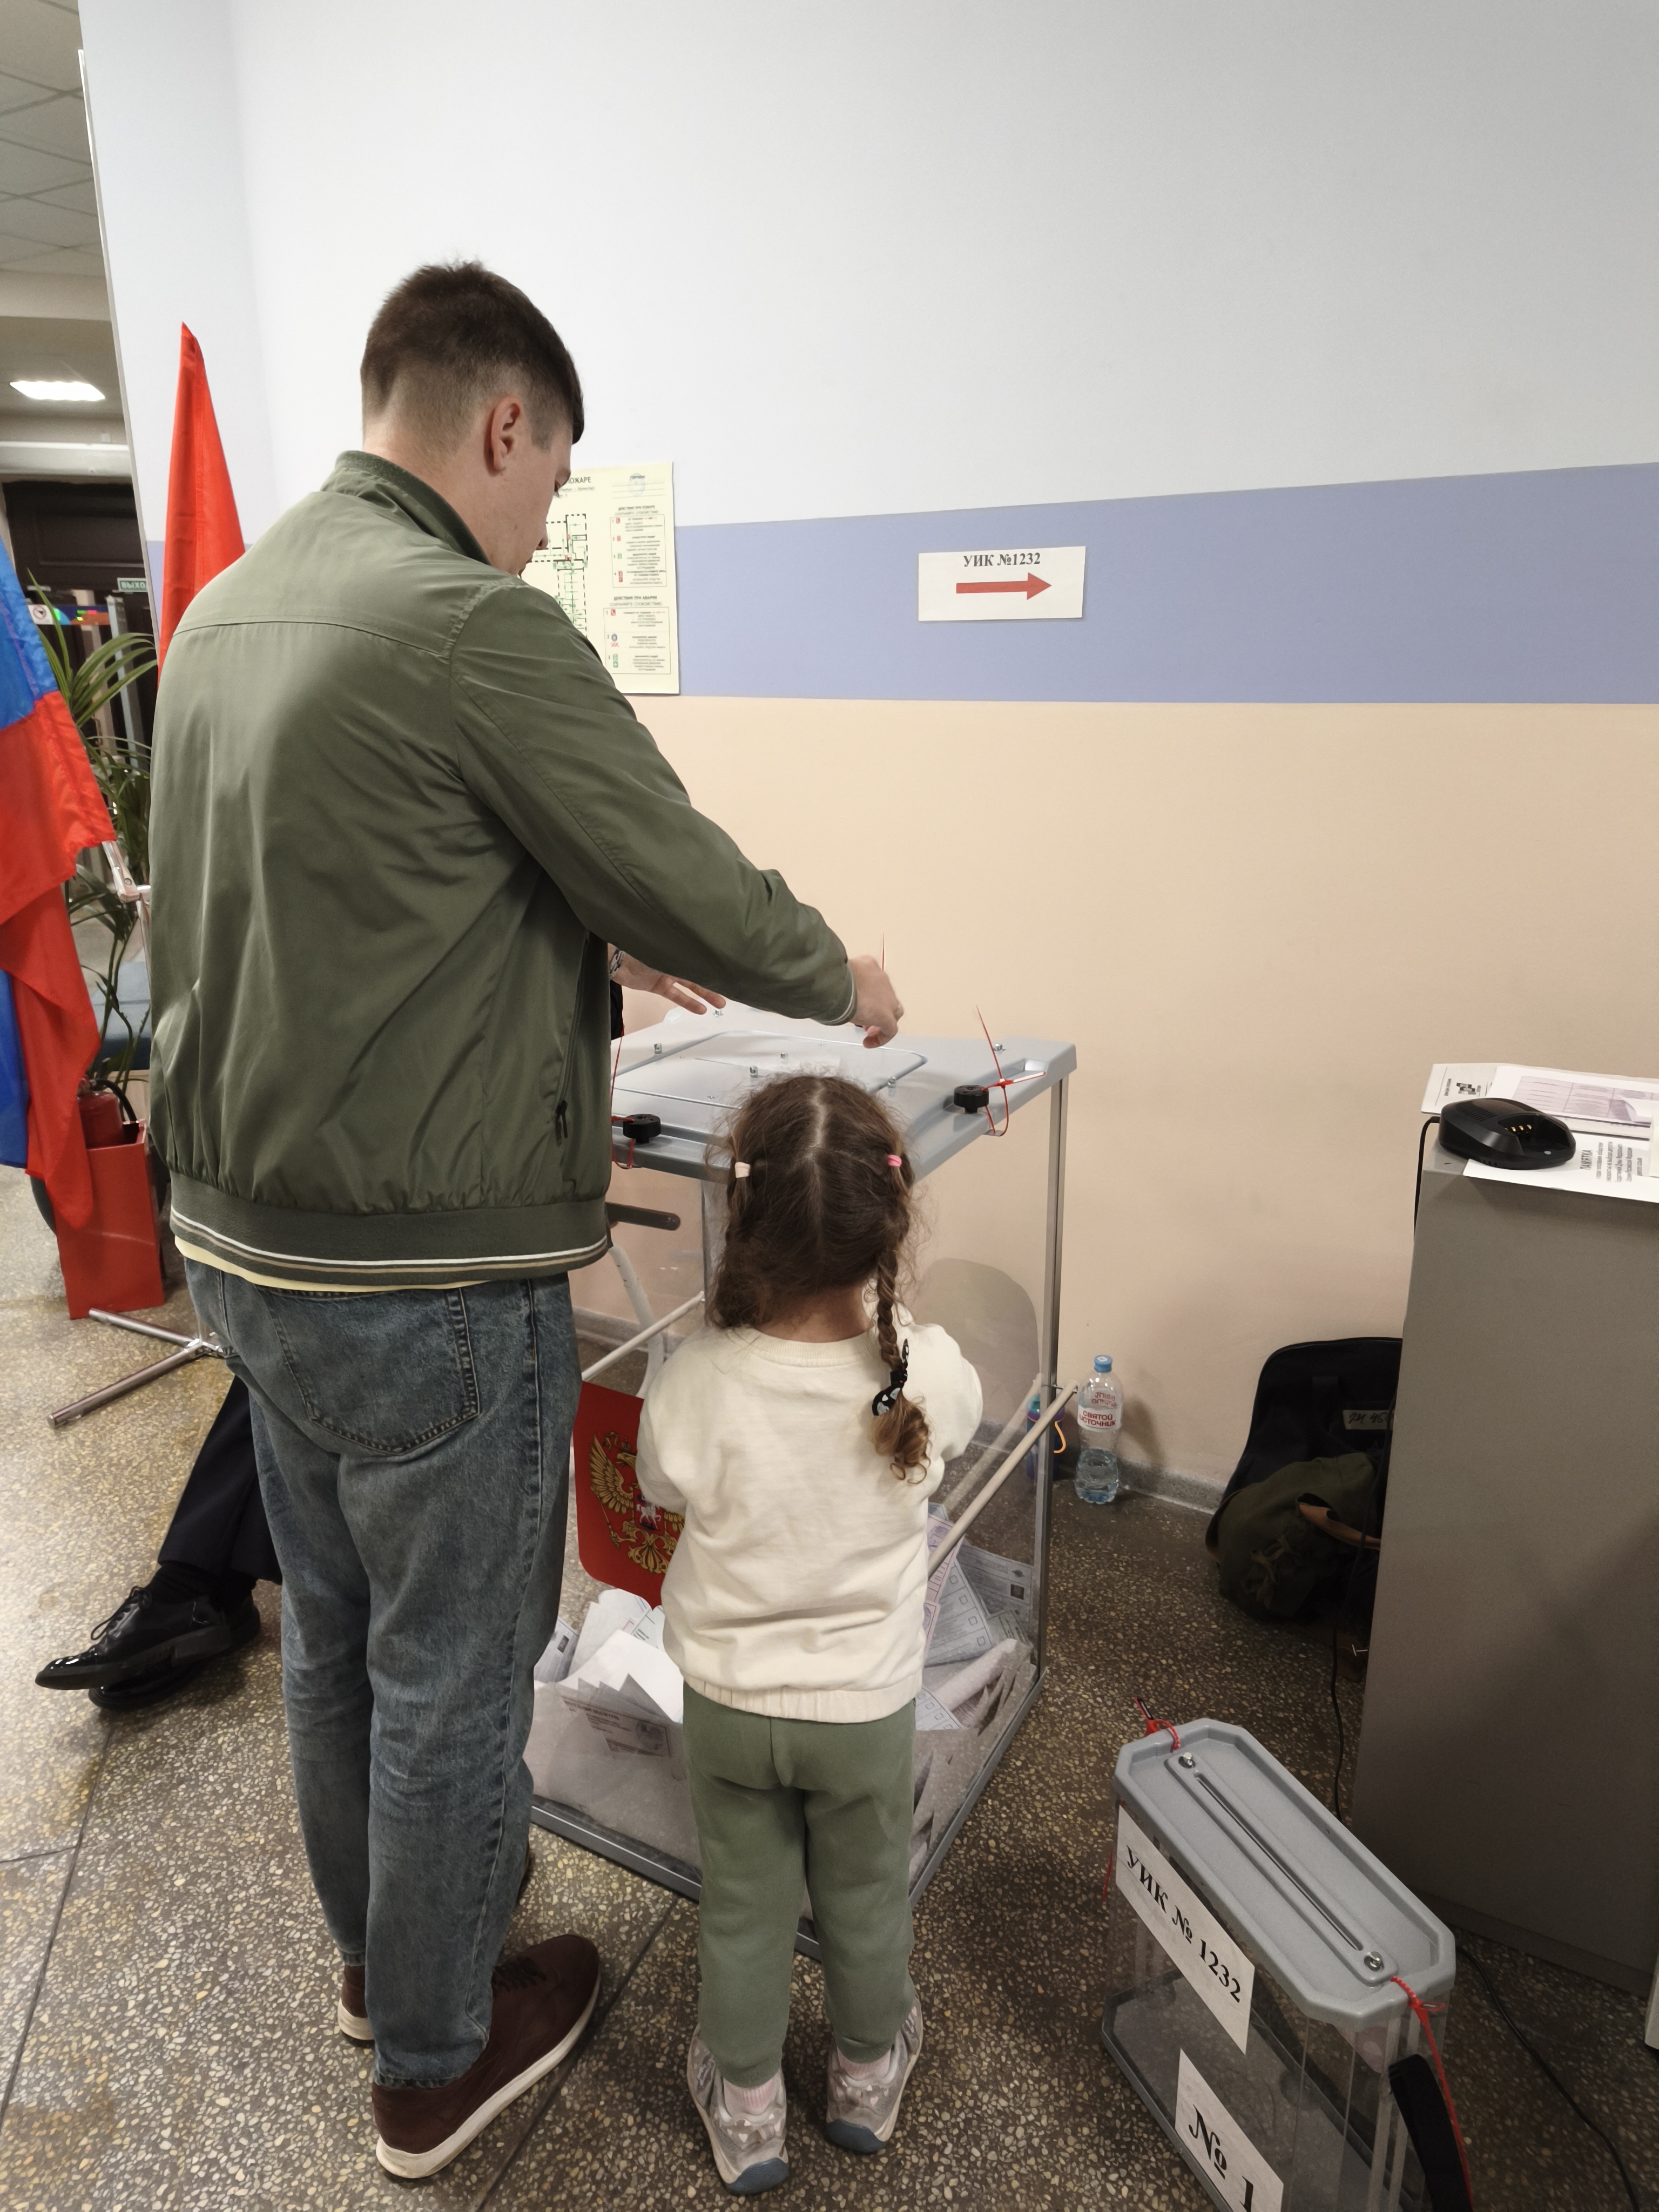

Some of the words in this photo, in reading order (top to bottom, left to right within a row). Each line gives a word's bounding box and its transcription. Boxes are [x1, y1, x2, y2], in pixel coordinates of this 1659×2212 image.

[963, 554, 994, 567] УИК
[997, 552, 1041, 566] №1232
[1580, 1150, 1593, 1170] ПАМЯТКА
[1079, 1414, 1116, 1426] ИСТОЧНИК
[1083, 1411, 1112, 1420] СВЯТОЙ
[1127, 1845, 1168, 1914] УИК
[1172, 1905, 1192, 1944] №
[1198, 1938, 1241, 2003] 1232
[1189, 2104, 1226, 2180] №
[1239, 2175, 1253, 2212] 1
